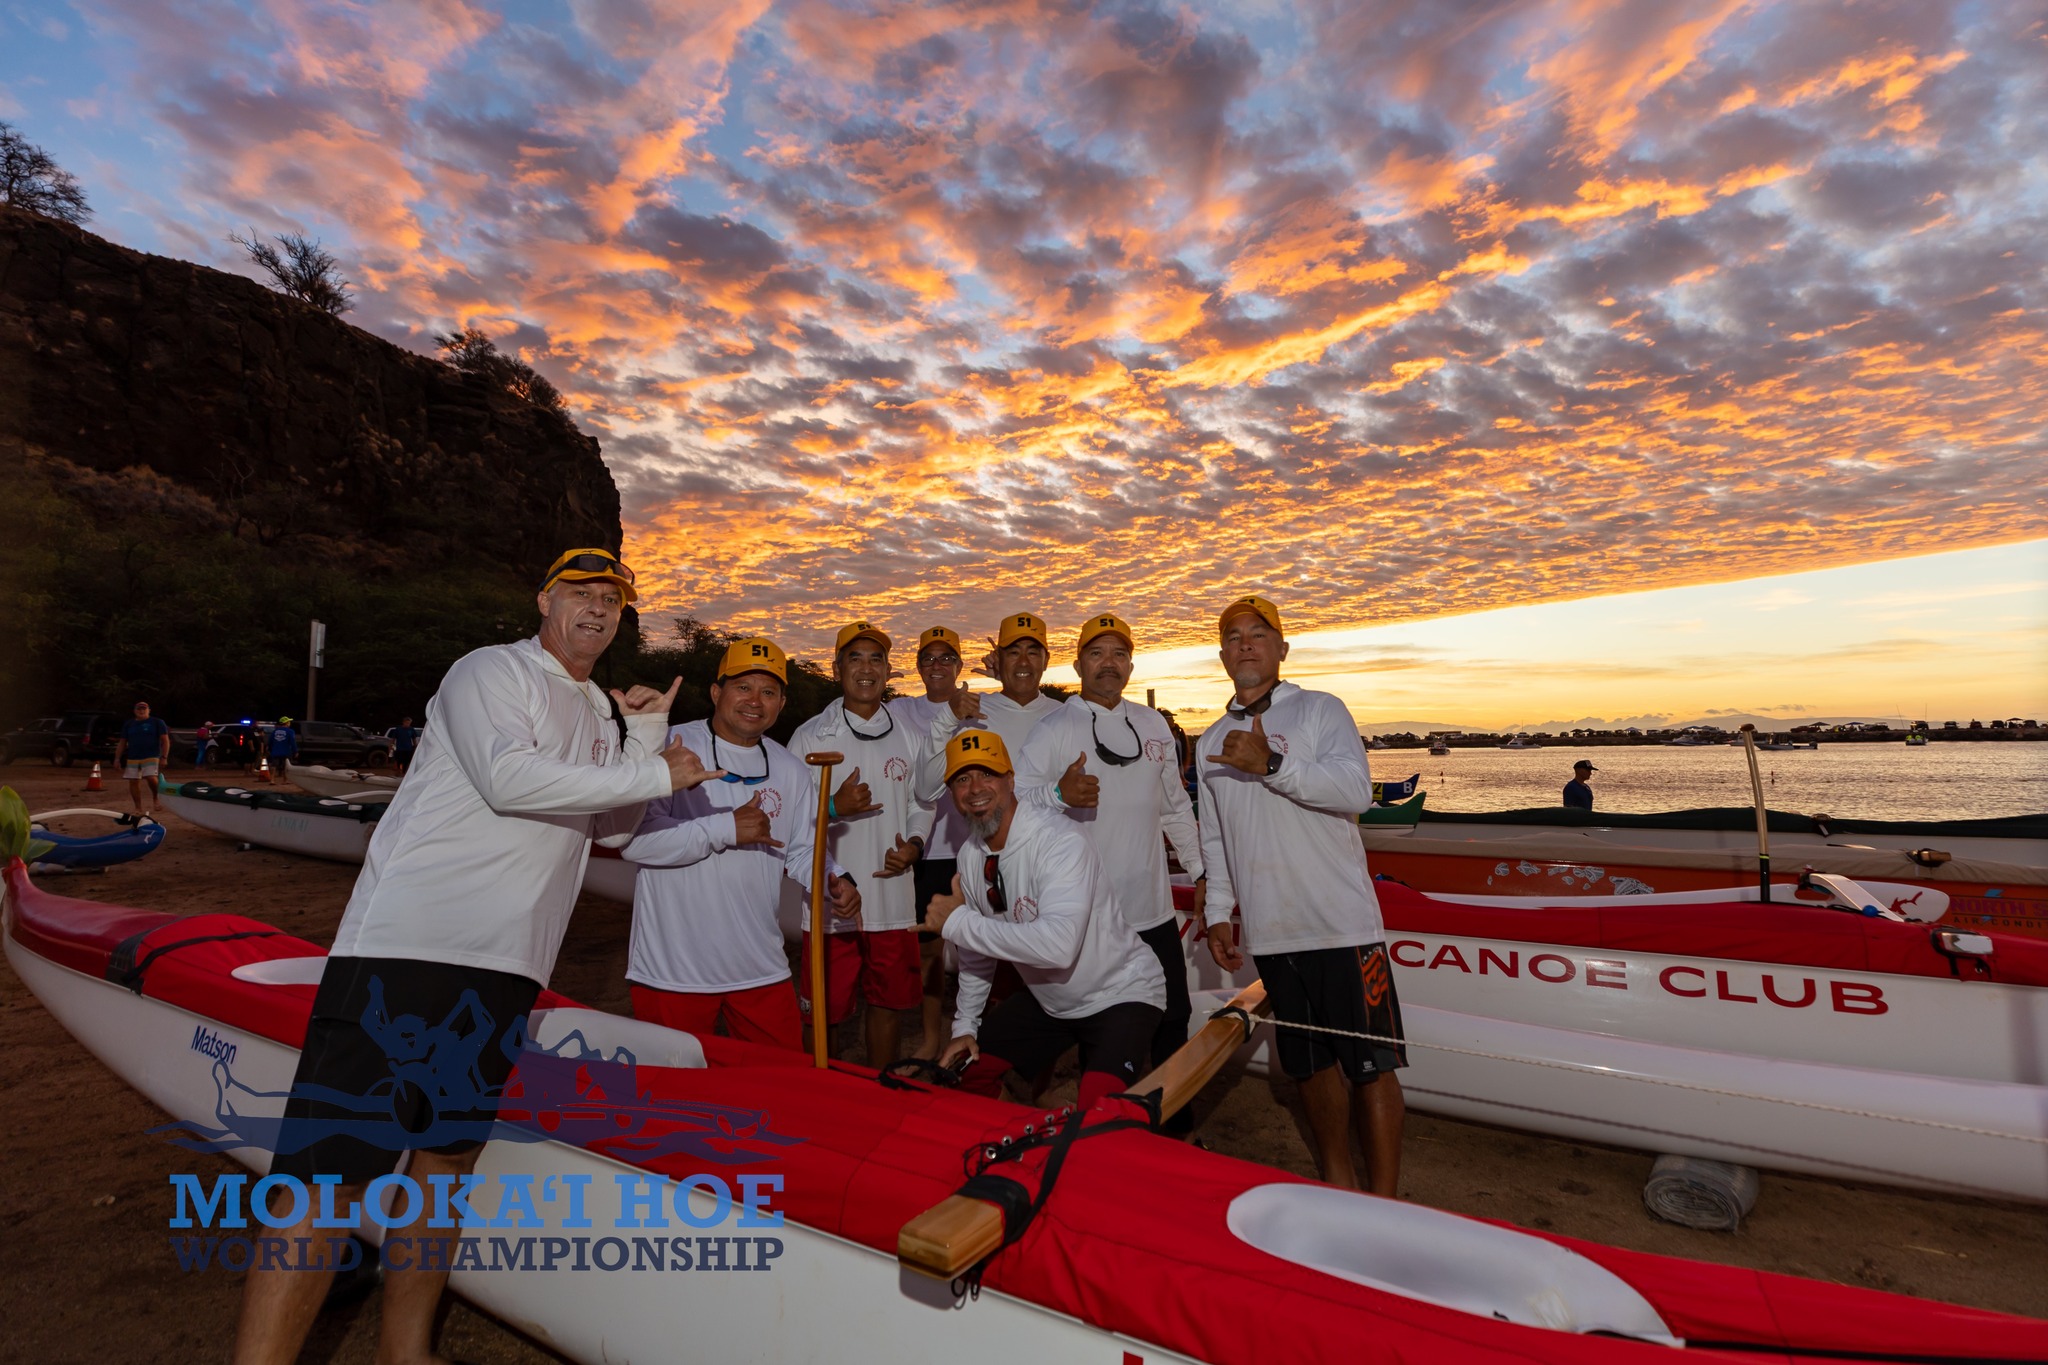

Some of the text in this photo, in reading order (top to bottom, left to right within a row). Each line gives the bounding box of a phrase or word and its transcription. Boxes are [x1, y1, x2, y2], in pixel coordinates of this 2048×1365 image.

[1017, 617, 1031, 627] 51
[1100, 619, 1114, 627] 51
[932, 629, 945, 637] 51
[752, 645, 768, 658] 51
[962, 736, 979, 751] 51
[1404, 782, 1413, 794] B
[1951, 898, 2026, 915] NORTH
[1954, 916, 1979, 925] AIR
[1389, 940, 1889, 1016] CANOE CLUB
[191, 1025, 237, 1064] Matson
